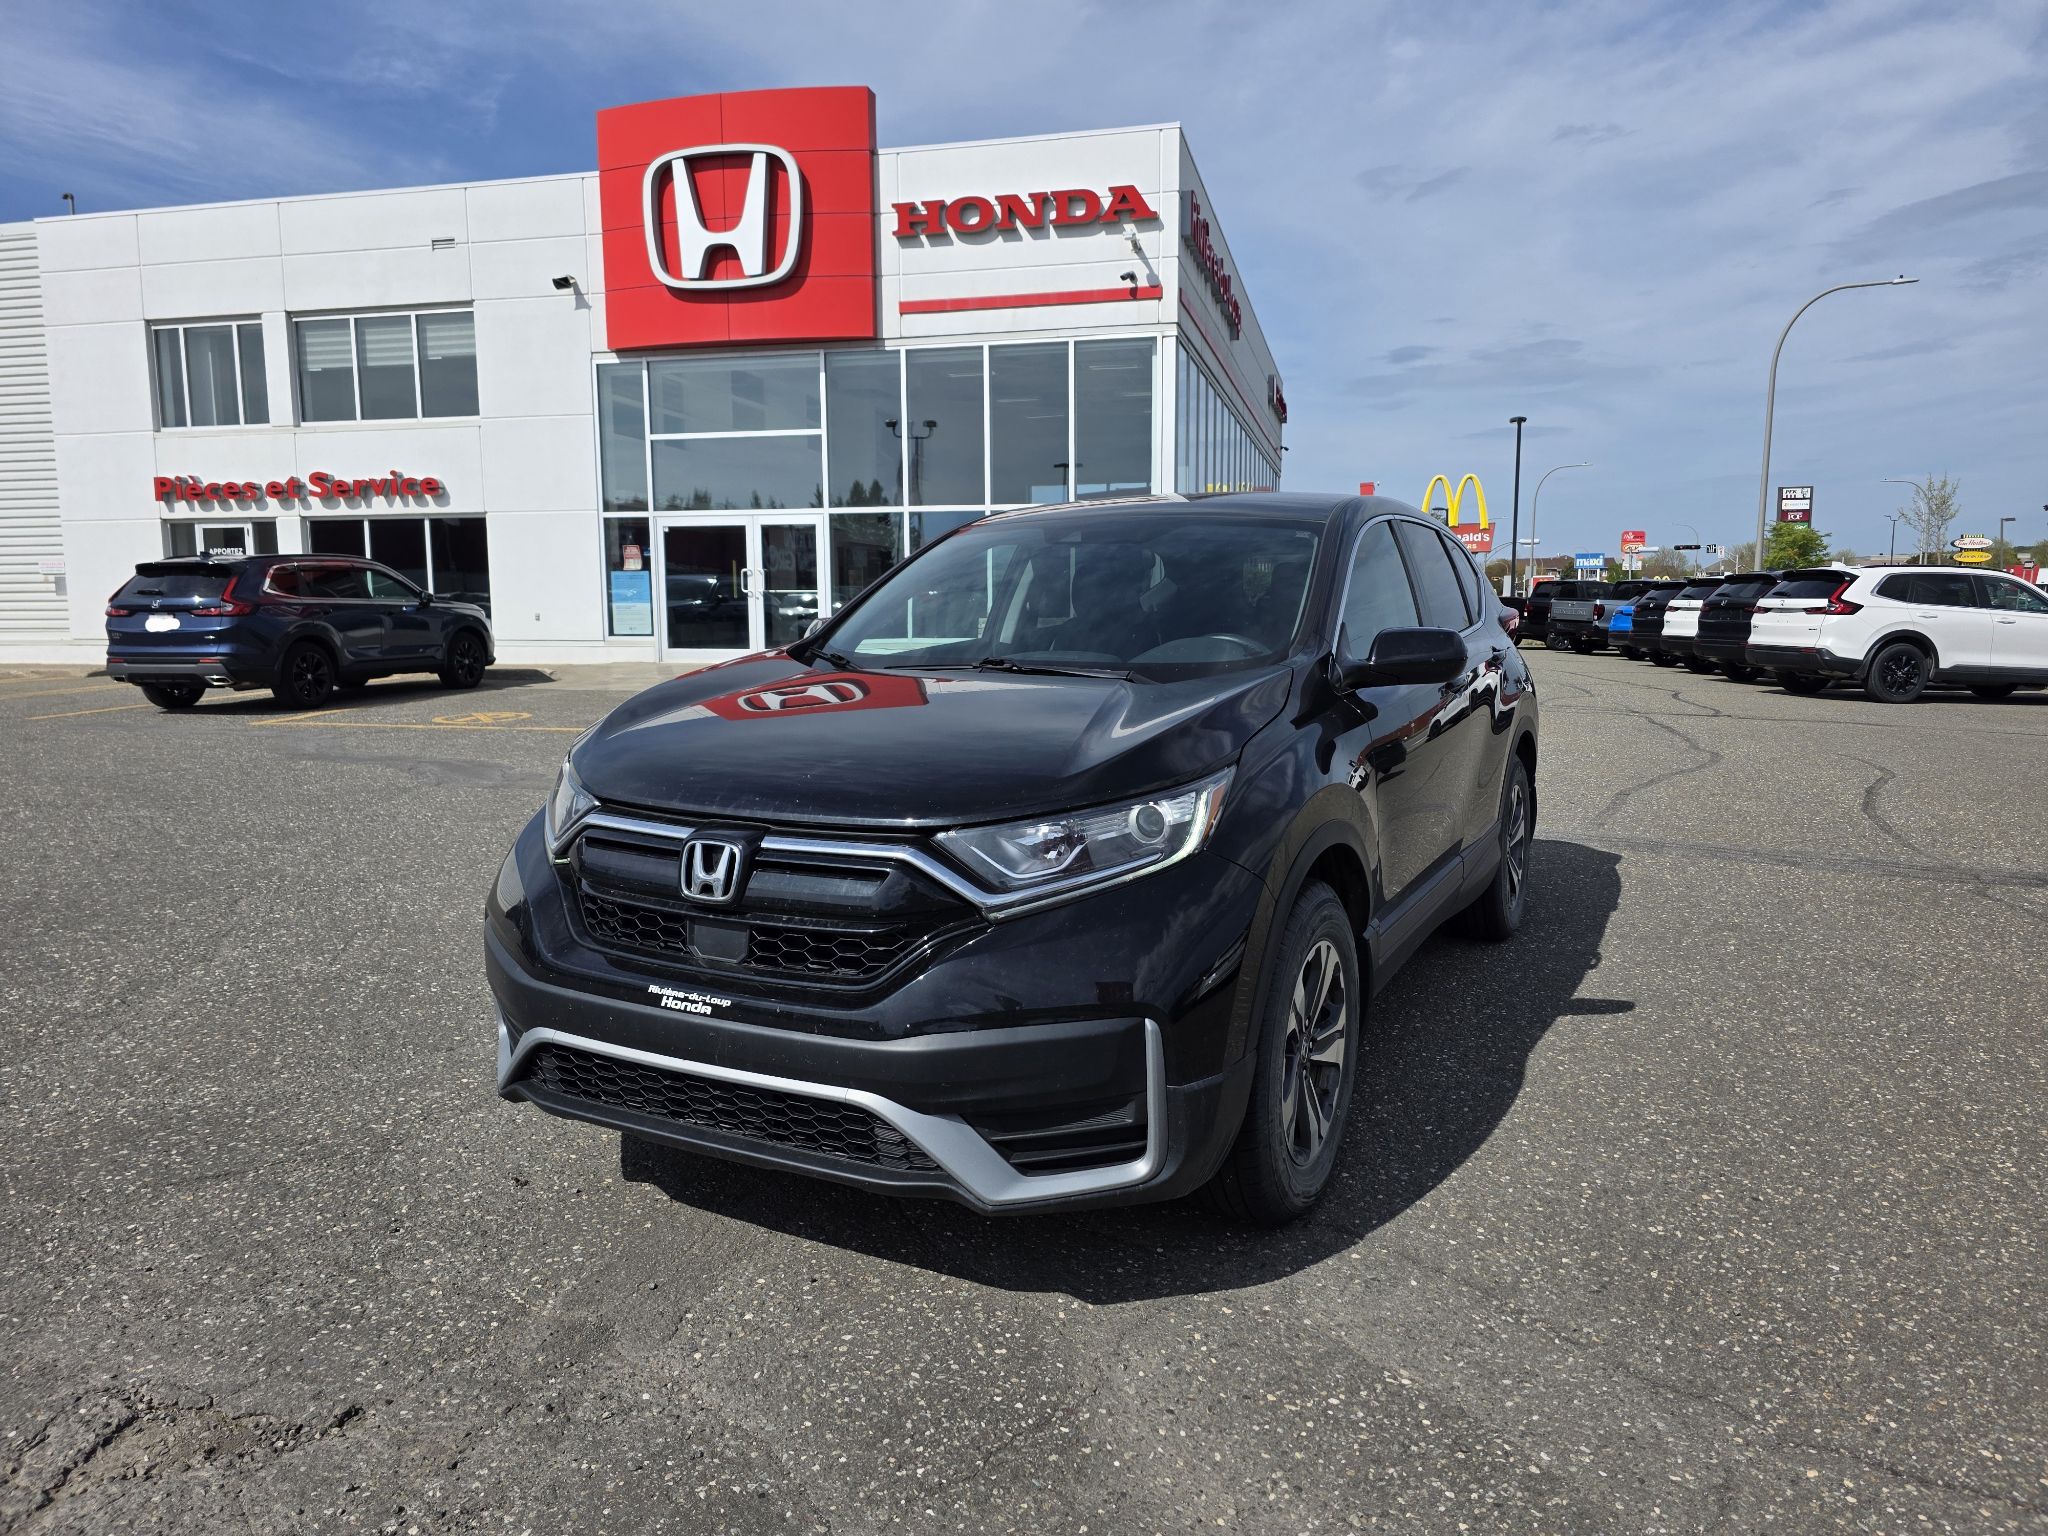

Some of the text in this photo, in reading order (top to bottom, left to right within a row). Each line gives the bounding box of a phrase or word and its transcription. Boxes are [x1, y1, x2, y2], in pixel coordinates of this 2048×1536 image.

[892, 184, 1158, 237] HONDA
[153, 469, 440, 502] Pièces et Service
[209, 547, 244, 555] APPORTEZ
[1576, 555, 1604, 567] maxi
[660, 995, 712, 1015] Honda
